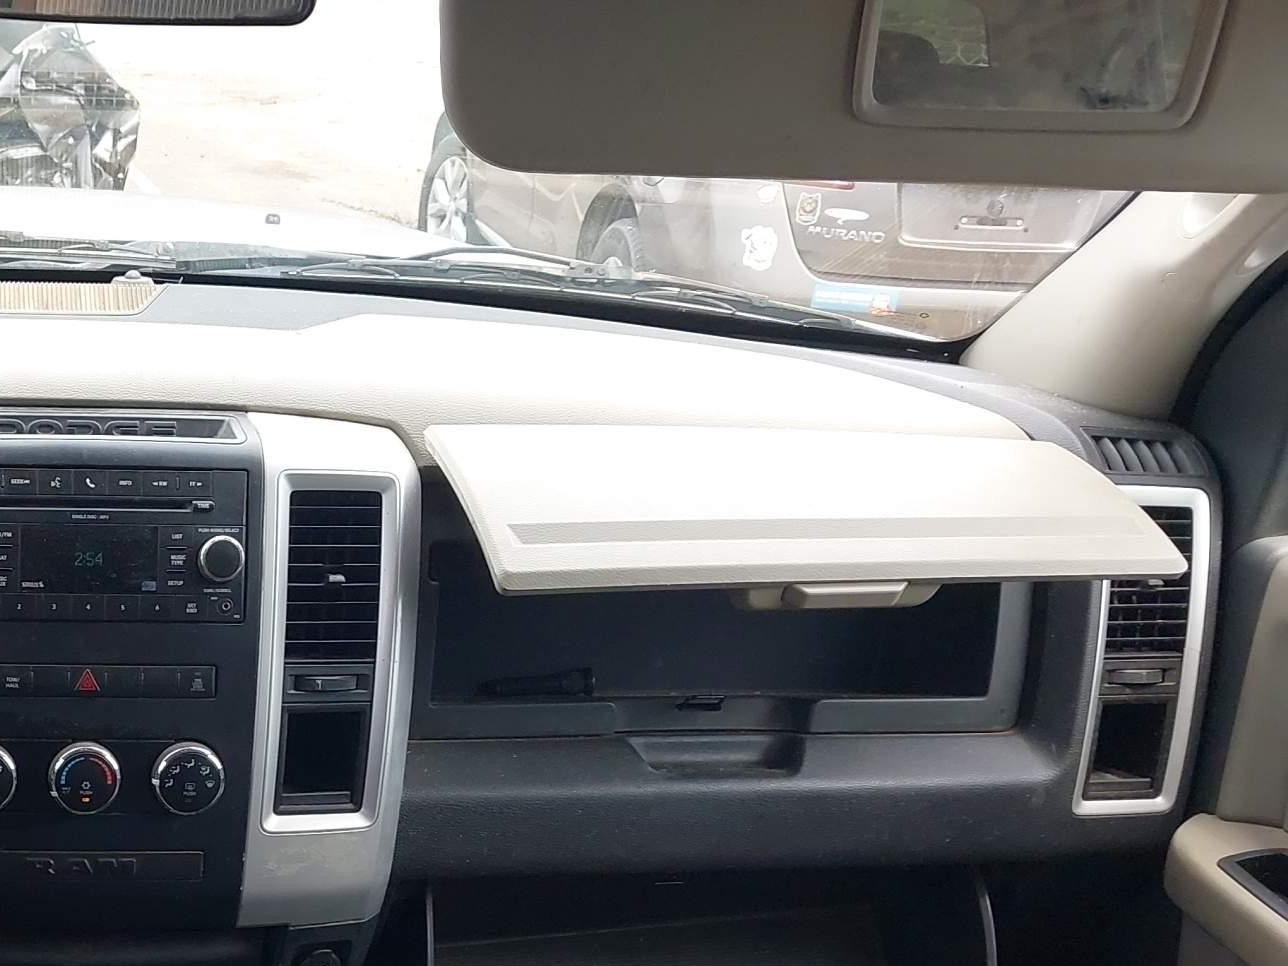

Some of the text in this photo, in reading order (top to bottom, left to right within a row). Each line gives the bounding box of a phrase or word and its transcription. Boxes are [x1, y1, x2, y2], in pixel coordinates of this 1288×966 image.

[807, 225, 886, 243] MURANO
[74, 551, 103, 567] 2:54
[25, 857, 137, 876] RAM
